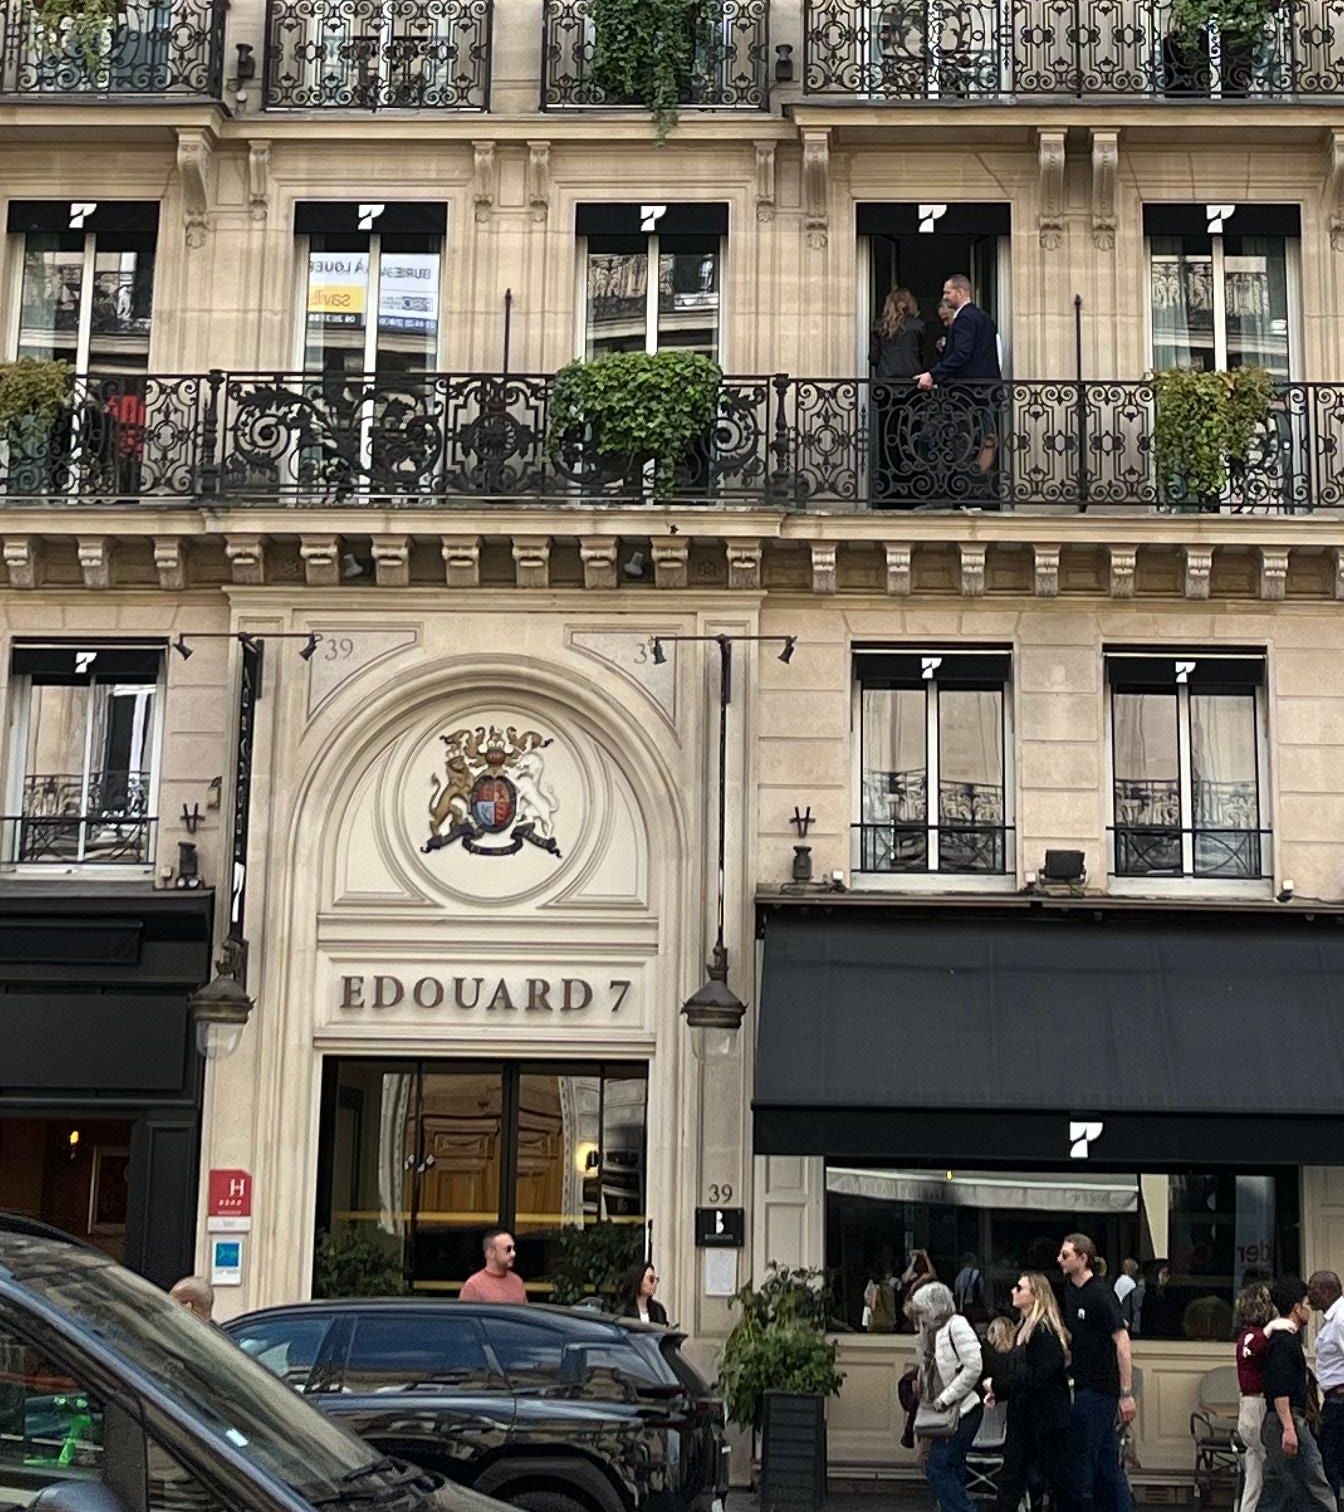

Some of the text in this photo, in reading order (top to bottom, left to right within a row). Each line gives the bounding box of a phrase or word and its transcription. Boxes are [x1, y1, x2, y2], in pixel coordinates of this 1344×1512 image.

[324, 637, 354, 662] 39
[339, 974, 632, 1013] EDOUARD 7
[228, 1178, 246, 1198] H
[708, 1183, 734, 1205] 39
